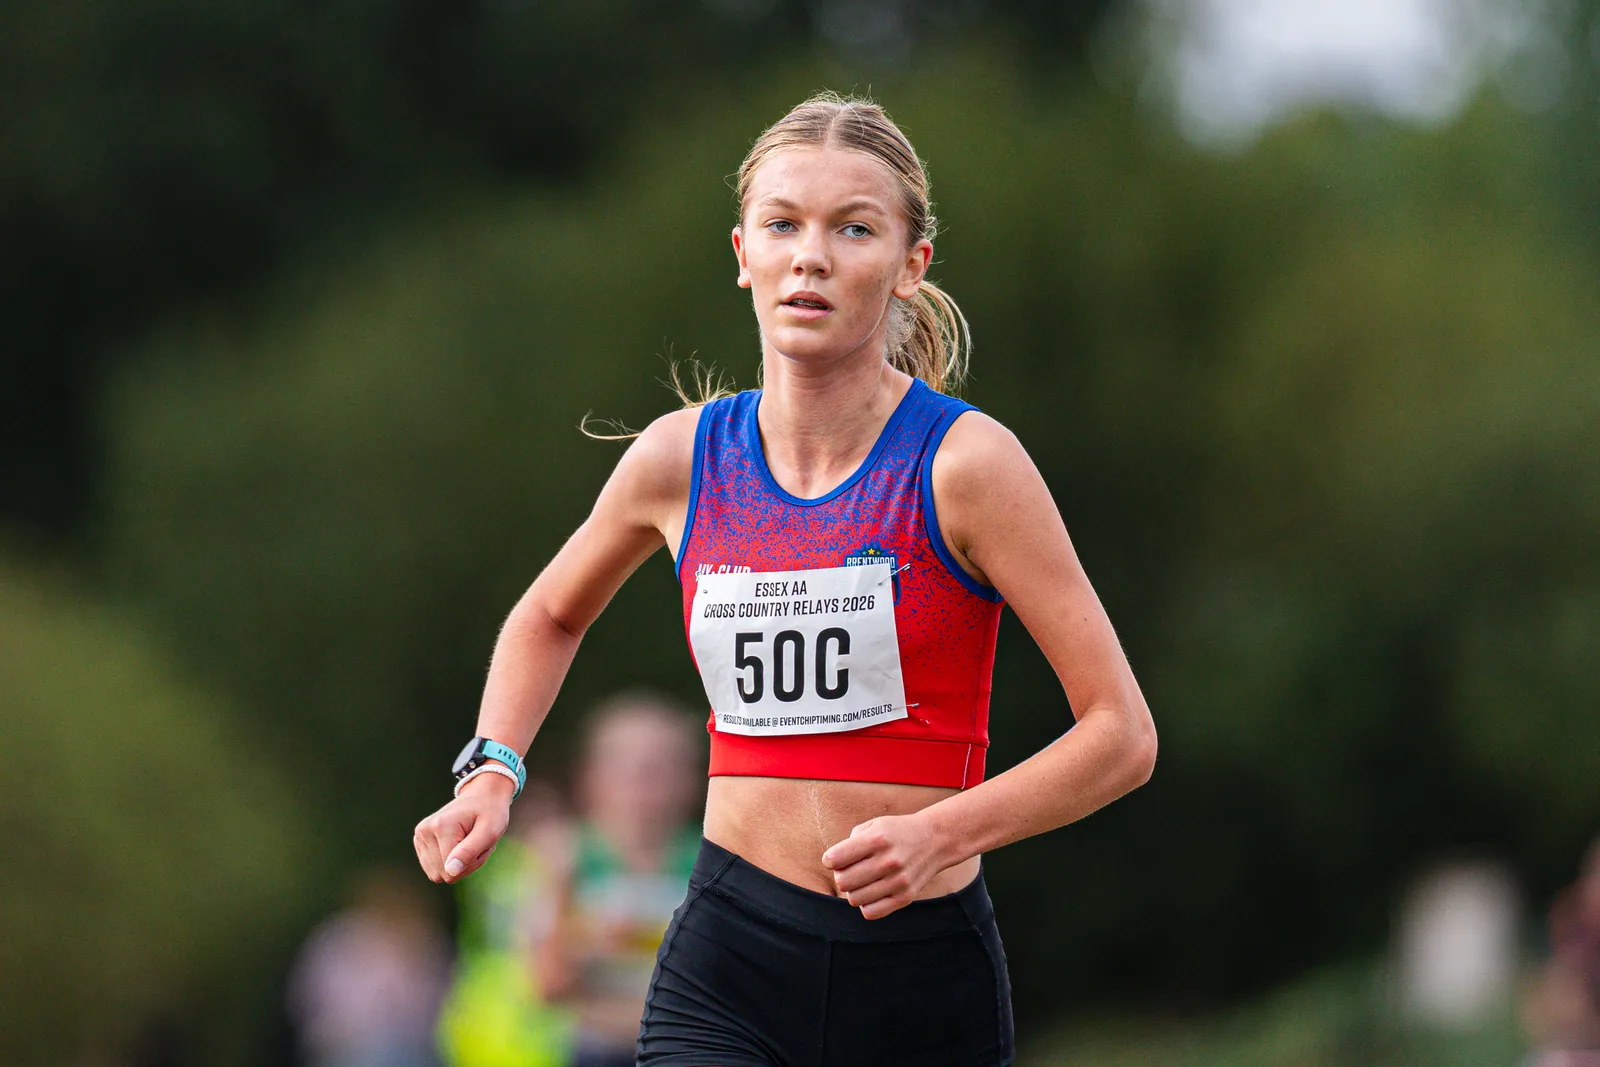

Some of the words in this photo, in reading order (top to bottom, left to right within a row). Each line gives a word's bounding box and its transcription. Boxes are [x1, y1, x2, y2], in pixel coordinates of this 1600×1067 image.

[755, 581, 789, 597] ESSEX
[791, 580, 808, 595] AA
[704, 603, 735, 618] CROSS
[738, 601, 789, 618] COUNTRY
[793, 598, 839, 615] RELAYS
[842, 595, 875, 612] 2026
[735, 627, 850, 704] 50C
[723, 714, 742, 726] RESULTS
[742, 716, 771, 727] AVAILABLE
[771, 717, 779, 728] @
[779, 703, 893, 727] EVENTCHIPTIMING.COM/RESULTS
